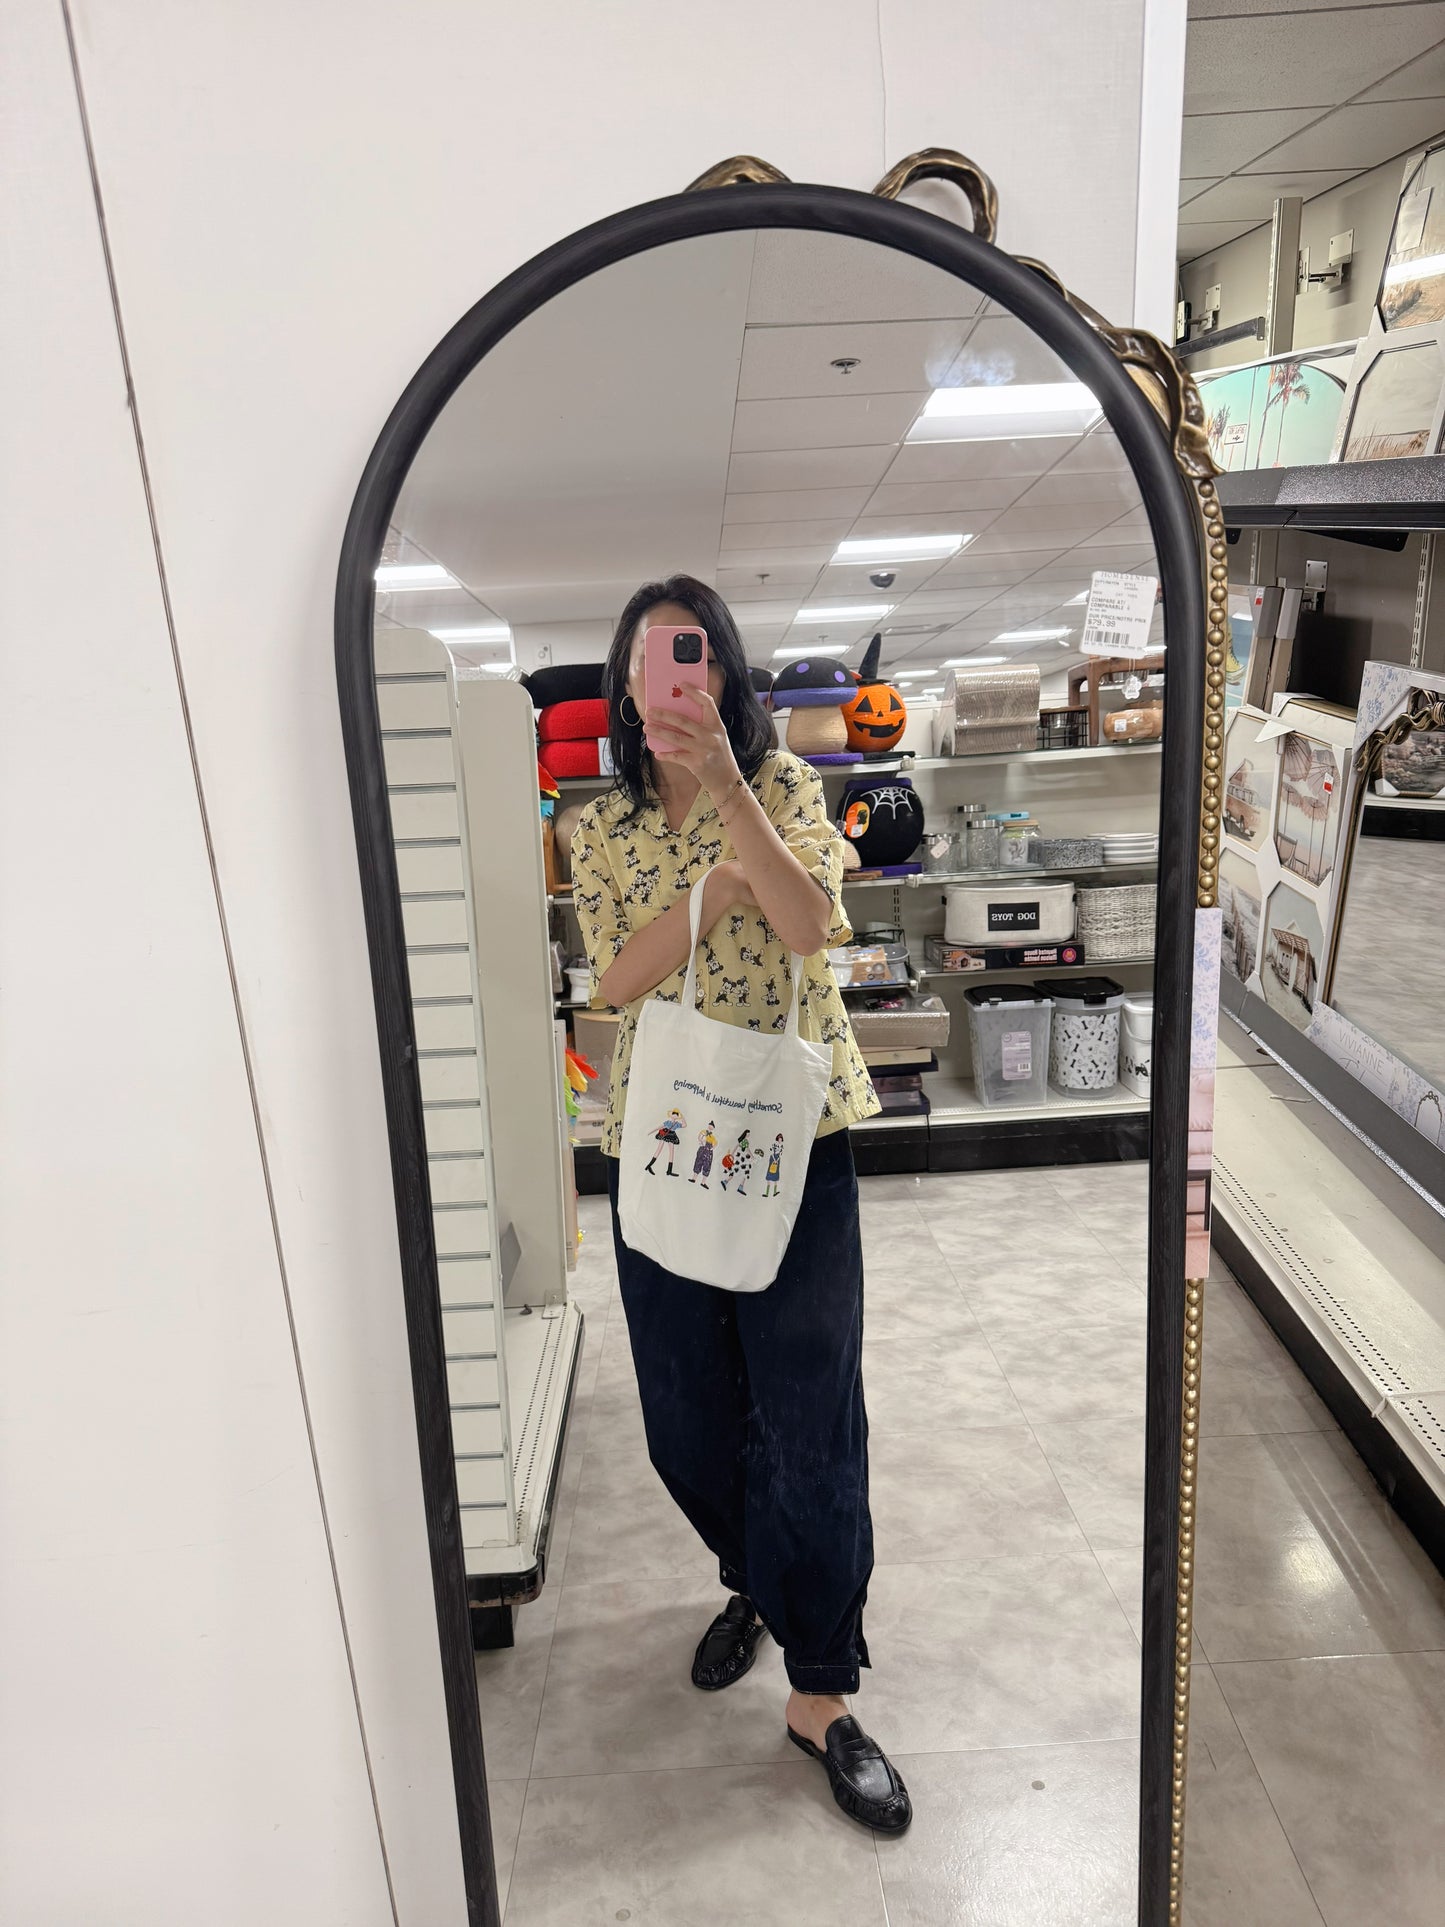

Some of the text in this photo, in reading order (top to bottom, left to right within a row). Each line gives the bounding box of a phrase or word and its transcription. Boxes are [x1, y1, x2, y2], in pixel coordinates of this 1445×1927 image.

[1091, 597, 1115, 605] COMPARE
[1087, 618, 1116, 628] $79.99
[1339, 1030, 1385, 1075] VIVIANNE
